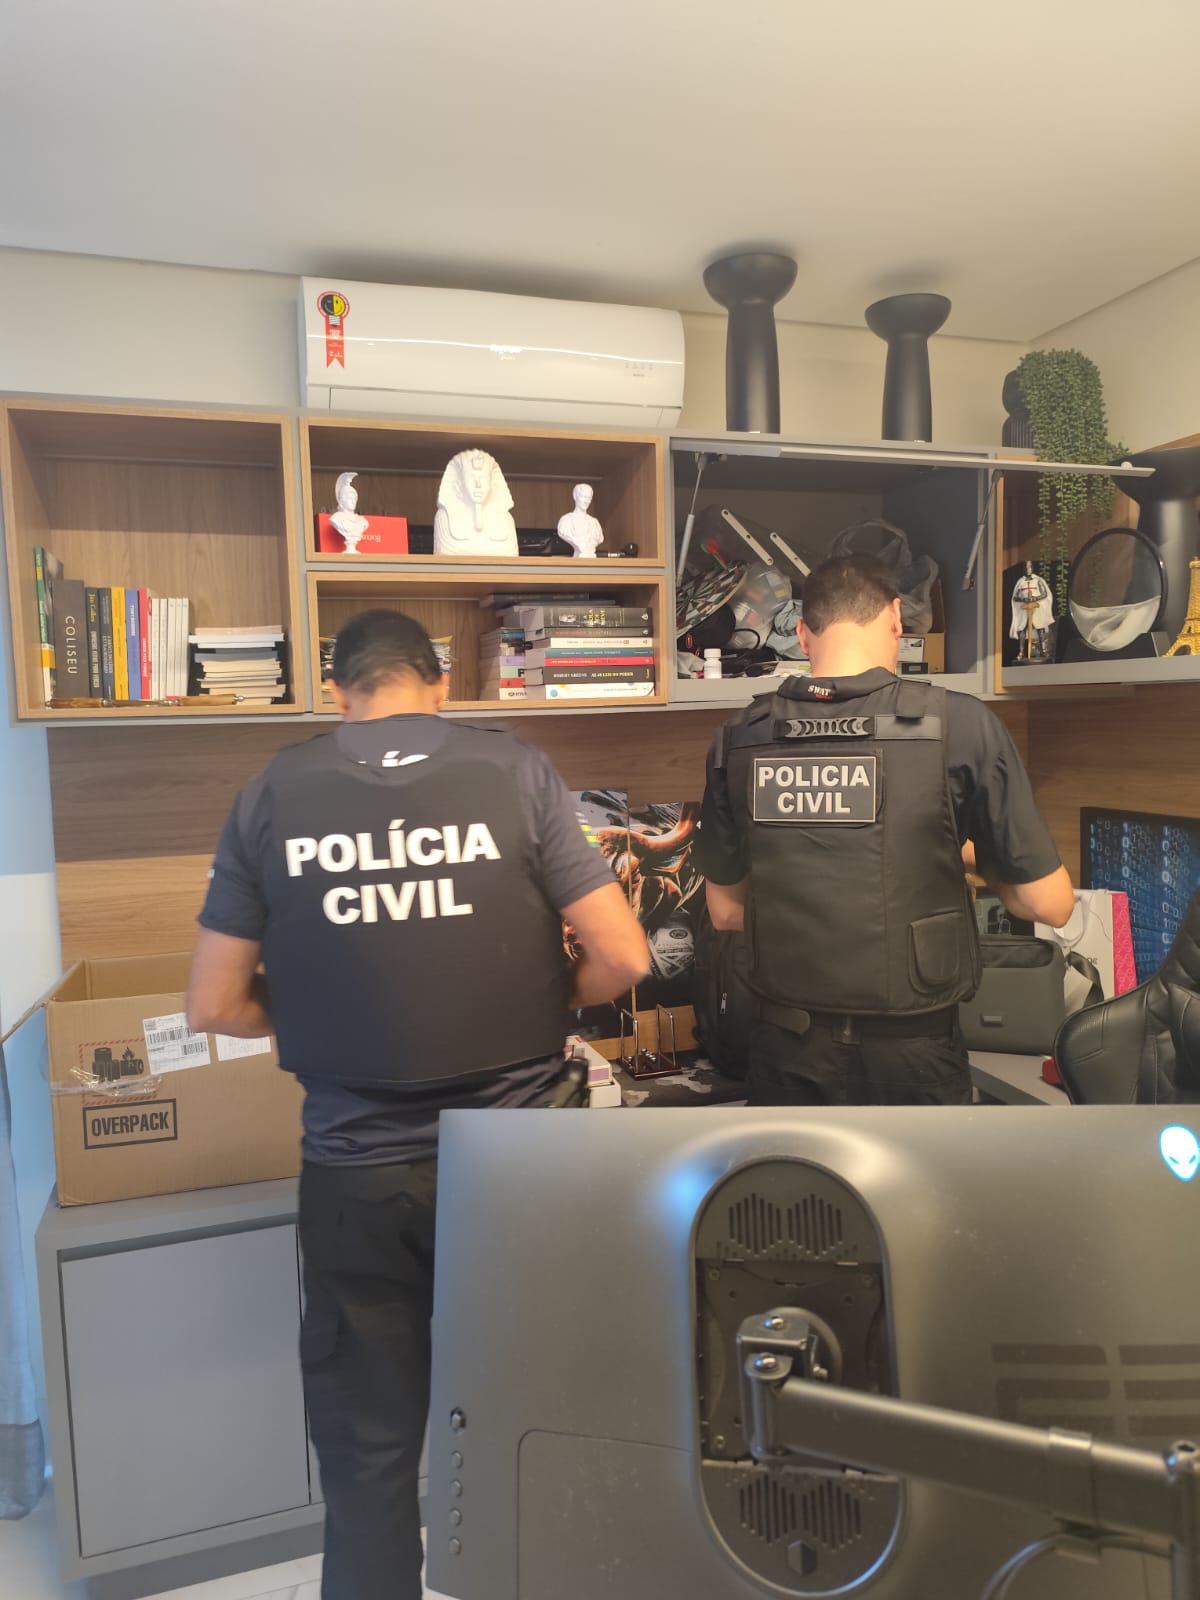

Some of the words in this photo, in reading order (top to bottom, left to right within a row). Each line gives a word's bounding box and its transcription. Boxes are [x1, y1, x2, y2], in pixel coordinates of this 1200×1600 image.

[65, 615, 78, 674] COLISEU
[807, 684, 832, 696] SWAT
[758, 765, 870, 788] POLICIA
[777, 792, 851, 814] CIVIL
[285, 818, 501, 878] POLÍCIA
[322, 878, 474, 926] CIVIL
[91, 1111, 169, 1137] OVERPACK
